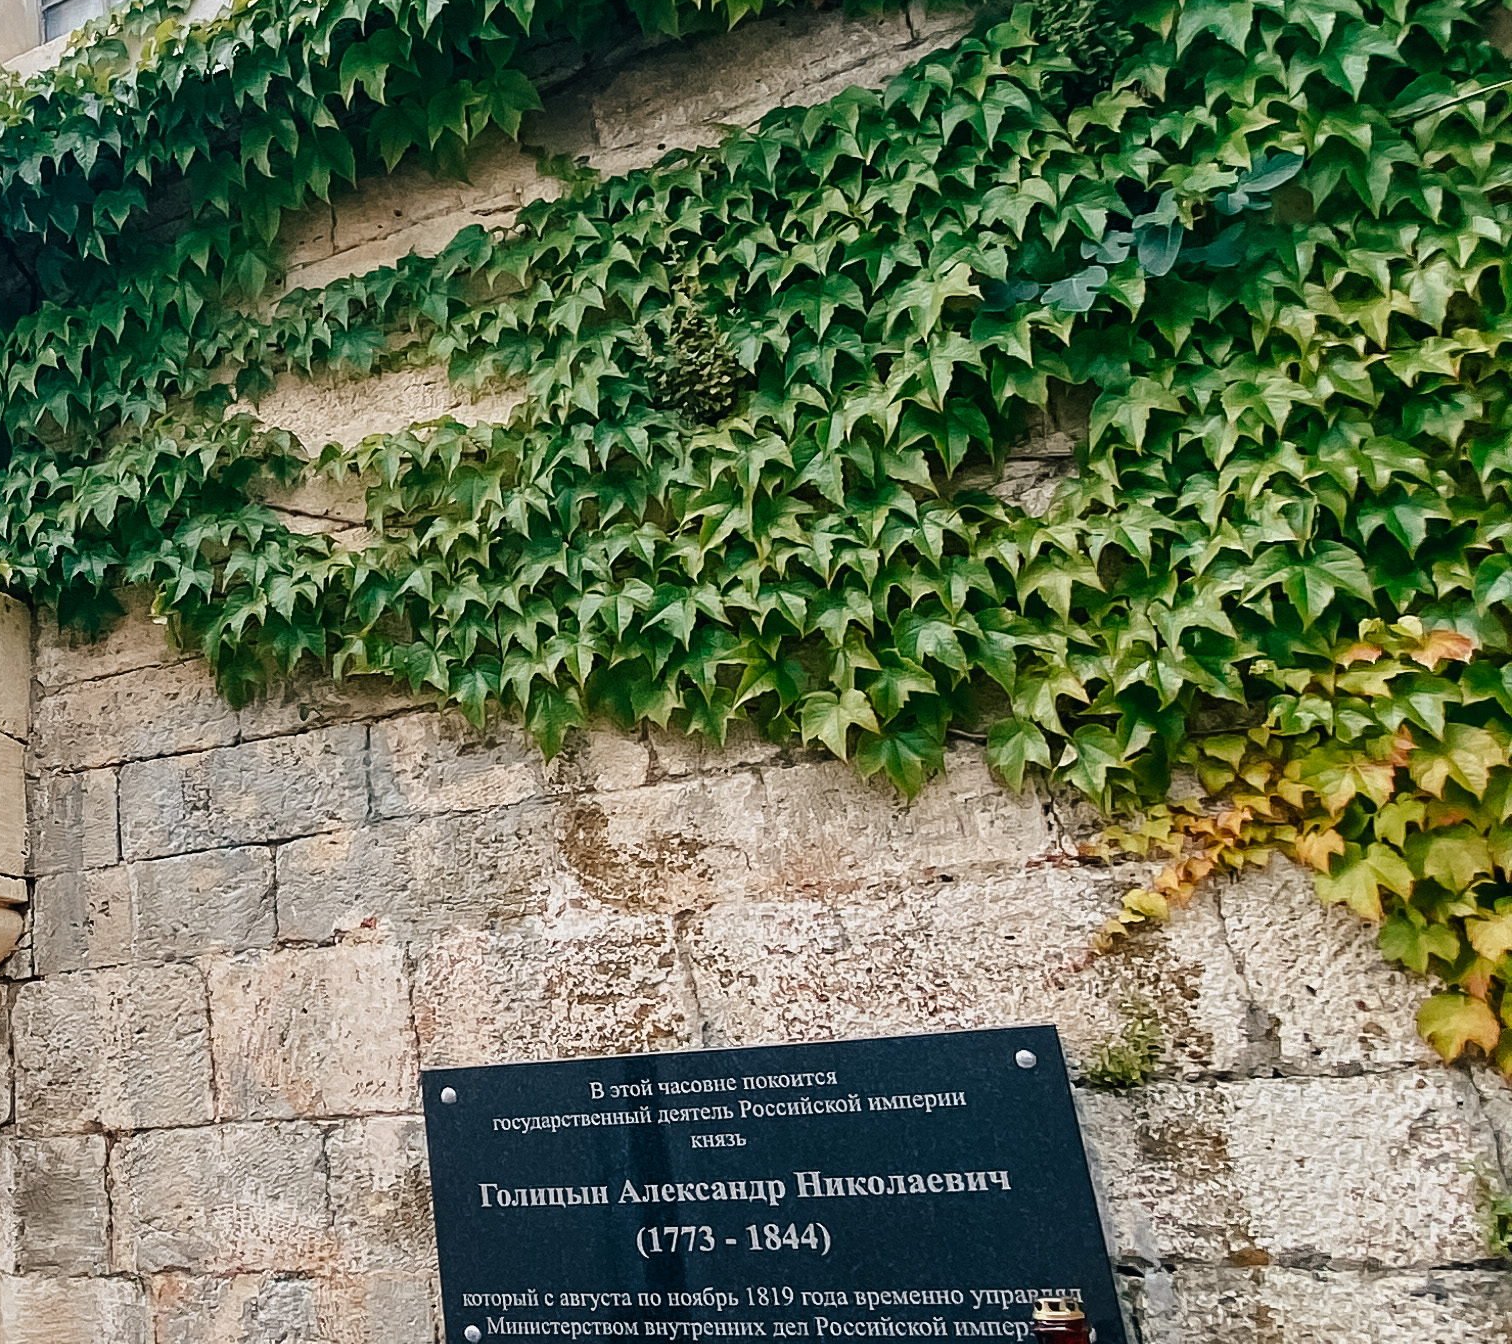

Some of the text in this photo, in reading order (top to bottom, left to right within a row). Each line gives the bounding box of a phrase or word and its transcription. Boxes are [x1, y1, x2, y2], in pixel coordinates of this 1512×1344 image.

[588, 1071, 838, 1100] В этой часовне покоится
[492, 1091, 967, 1134] государственный деятель Российской империи
[689, 1133, 747, 1149] князь
[477, 1170, 1012, 1209] Голицын Александр Николаевич
[636, 1225, 715, 1259] (1773
[745, 1222, 831, 1256] 1844)
[462, 1288, 540, 1312] который
[544, 1292, 555, 1307] с
[559, 1292, 633, 1312] августа
[637, 1292, 662, 1307] по
[667, 1286, 739, 1312] ноябрь
[745, 1285, 794, 1307] 1819
[800, 1291, 849, 1309] года
[853, 1289, 964, 1311] временно
[485, 1316, 1038, 1343] Министерством внутренних дел Российской импер
